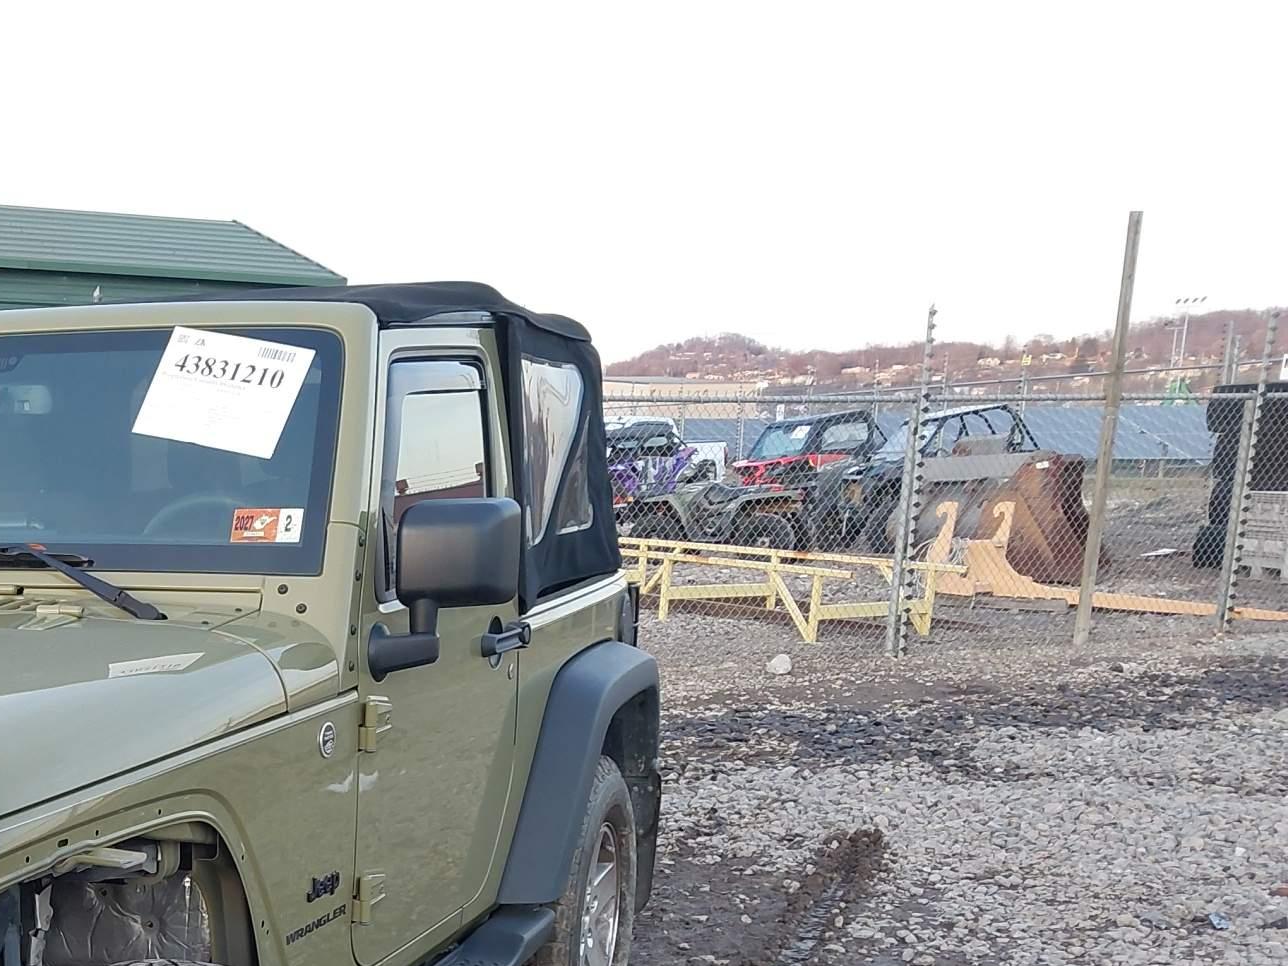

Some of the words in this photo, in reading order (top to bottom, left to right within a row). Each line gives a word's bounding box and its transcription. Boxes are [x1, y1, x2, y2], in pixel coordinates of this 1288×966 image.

[174, 353, 285, 389] 43831210
[234, 515, 255, 531] 2027
[284, 514, 293, 532] 2
[285, 904, 346, 946] WRANGLER
